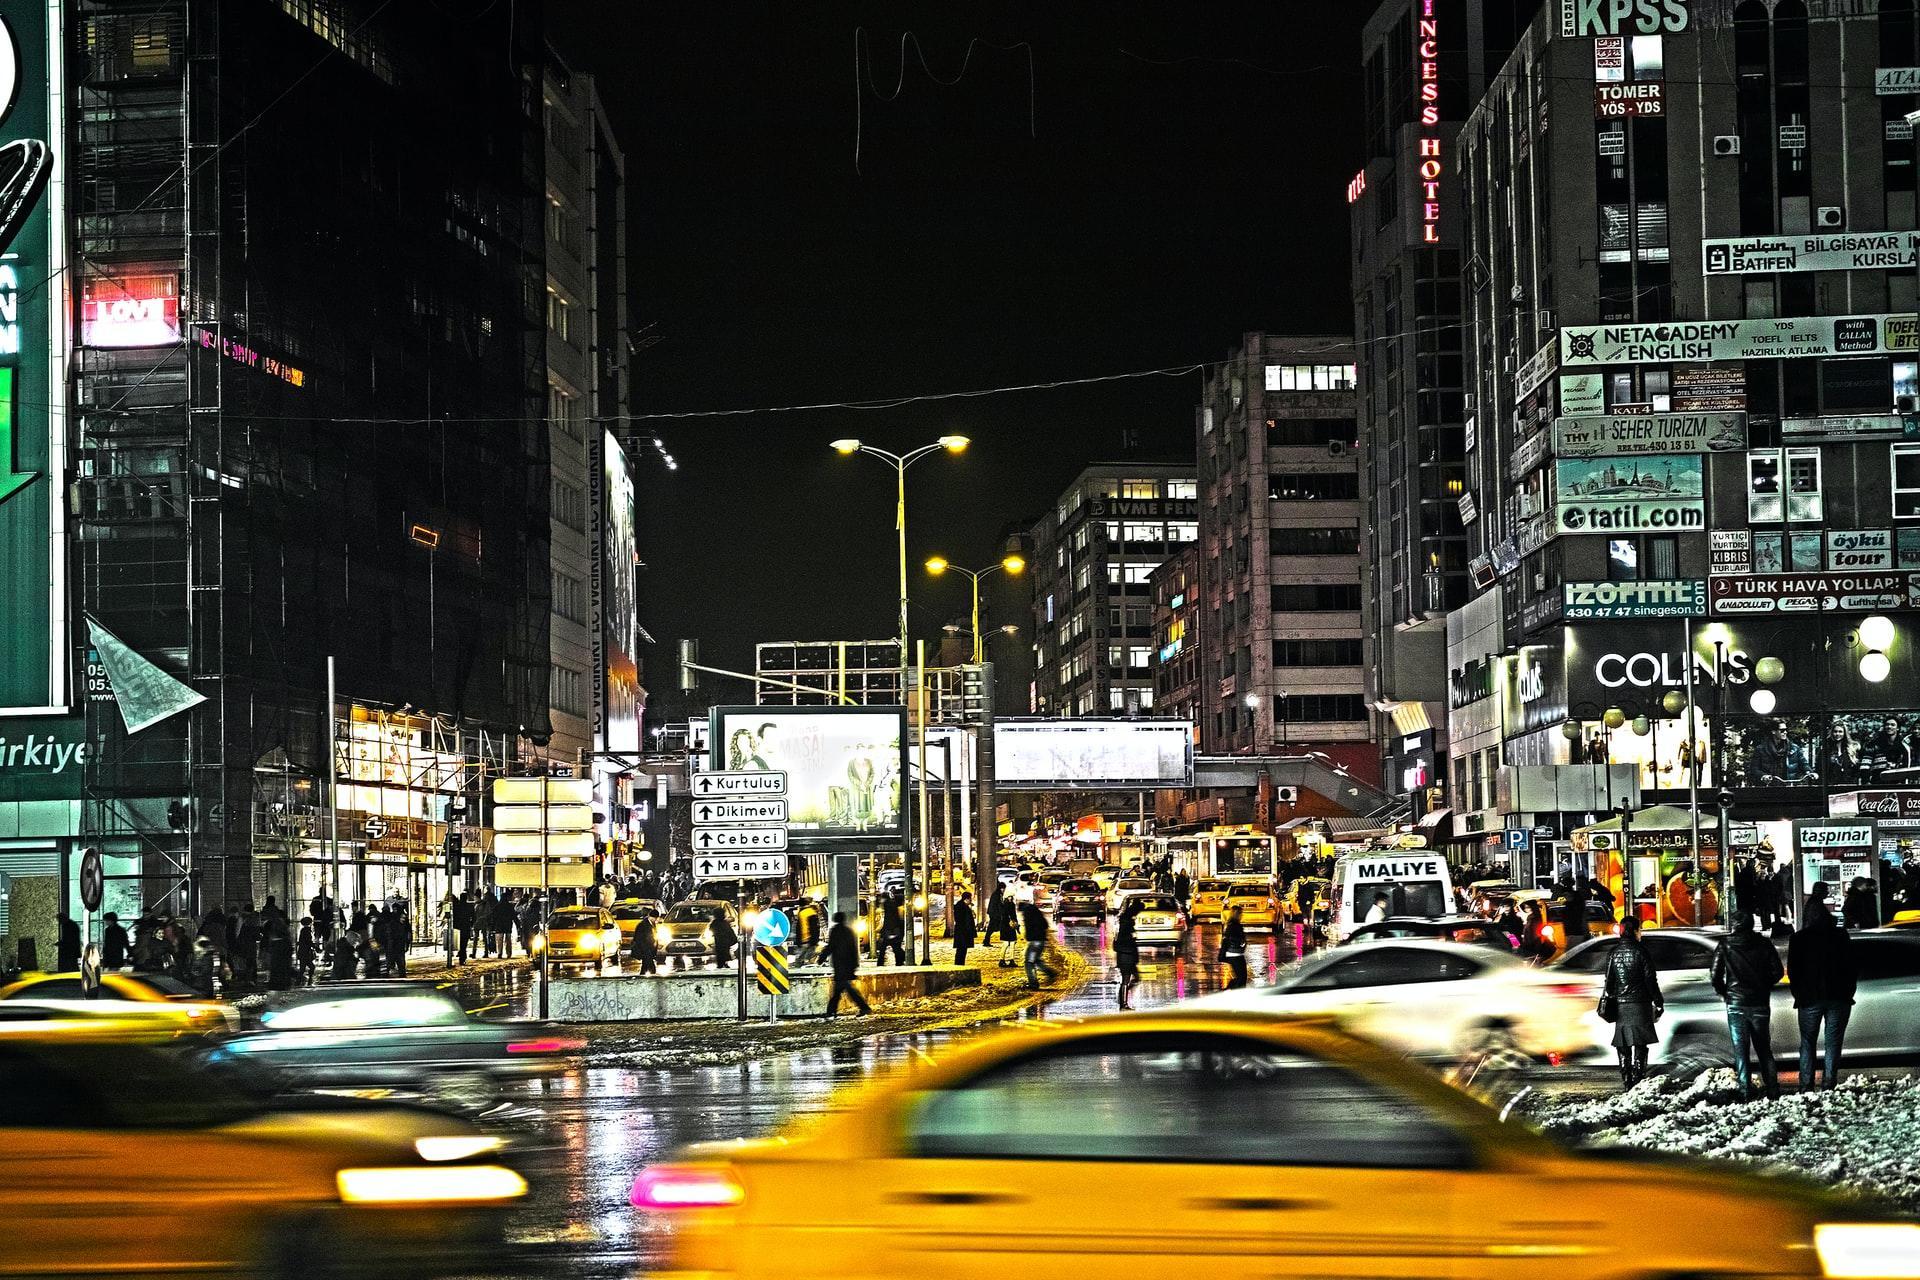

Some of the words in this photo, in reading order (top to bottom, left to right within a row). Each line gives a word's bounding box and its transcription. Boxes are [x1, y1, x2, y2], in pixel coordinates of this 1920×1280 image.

[1564, 0, 1574, 36] RDEM
[1579, 0, 1688, 36] KPSS
[1878, 70, 1920, 86] ATA
[1599, 84, 1661, 100] TÖMER
[1601, 101, 1626, 116] YÖS
[1636, 101, 1661, 114] YDS
[1420, 139, 1441, 242] HOTEL
[1804, 236, 1899, 252] BİLGİSAYAR
[1774, 322, 1794, 330] YDS
[1845, 321, 1865, 329] with
[1604, 323, 1740, 344] NETACADEMY
[1752, 336, 1783, 344] TOEFL
[1791, 334, 1818, 342] IELTS
[1839, 331, 1873, 340] CALLAN
[1628, 343, 1712, 361] ENGLISH
[1787, 346, 1829, 355] ATLAMA
[1839, 341, 1873, 350] Method
[1658, 415, 1707, 438] TURİZM
[1564, 432, 1590, 443] THY
[1588, 504, 1702, 528] tatil.com
[1712, 533, 1748, 541] YURTİÇİ
[1834, 533, 1885, 550] öykü
[1712, 542, 1748, 550] YURTDIŞI
[1713, 551, 1748, 562] KIBRIS
[1835, 552, 1885, 566] tour
[1735, 578, 1778, 593] TÜRK
[1782, 580, 1829, 592] HAVA
[1695, 581, 1705, 614] com
[1785, 597, 1829, 606] PEGASS
[1567, 608, 1592, 617] 430
[1595, 608, 1612, 616] 47
[1615, 607, 1632, 616] 47
[1719, 601, 1772, 609] ANADOLUJET
[1596, 650, 1750, 688] COLIN'S
[717, 776, 781, 790] Kurtuluş
[717, 804, 781, 817] Dikimevi
[717, 833, 777, 845] Cebeci
[1510, 830, 1524, 848] P
[717, 859, 781, 872] Mamak
